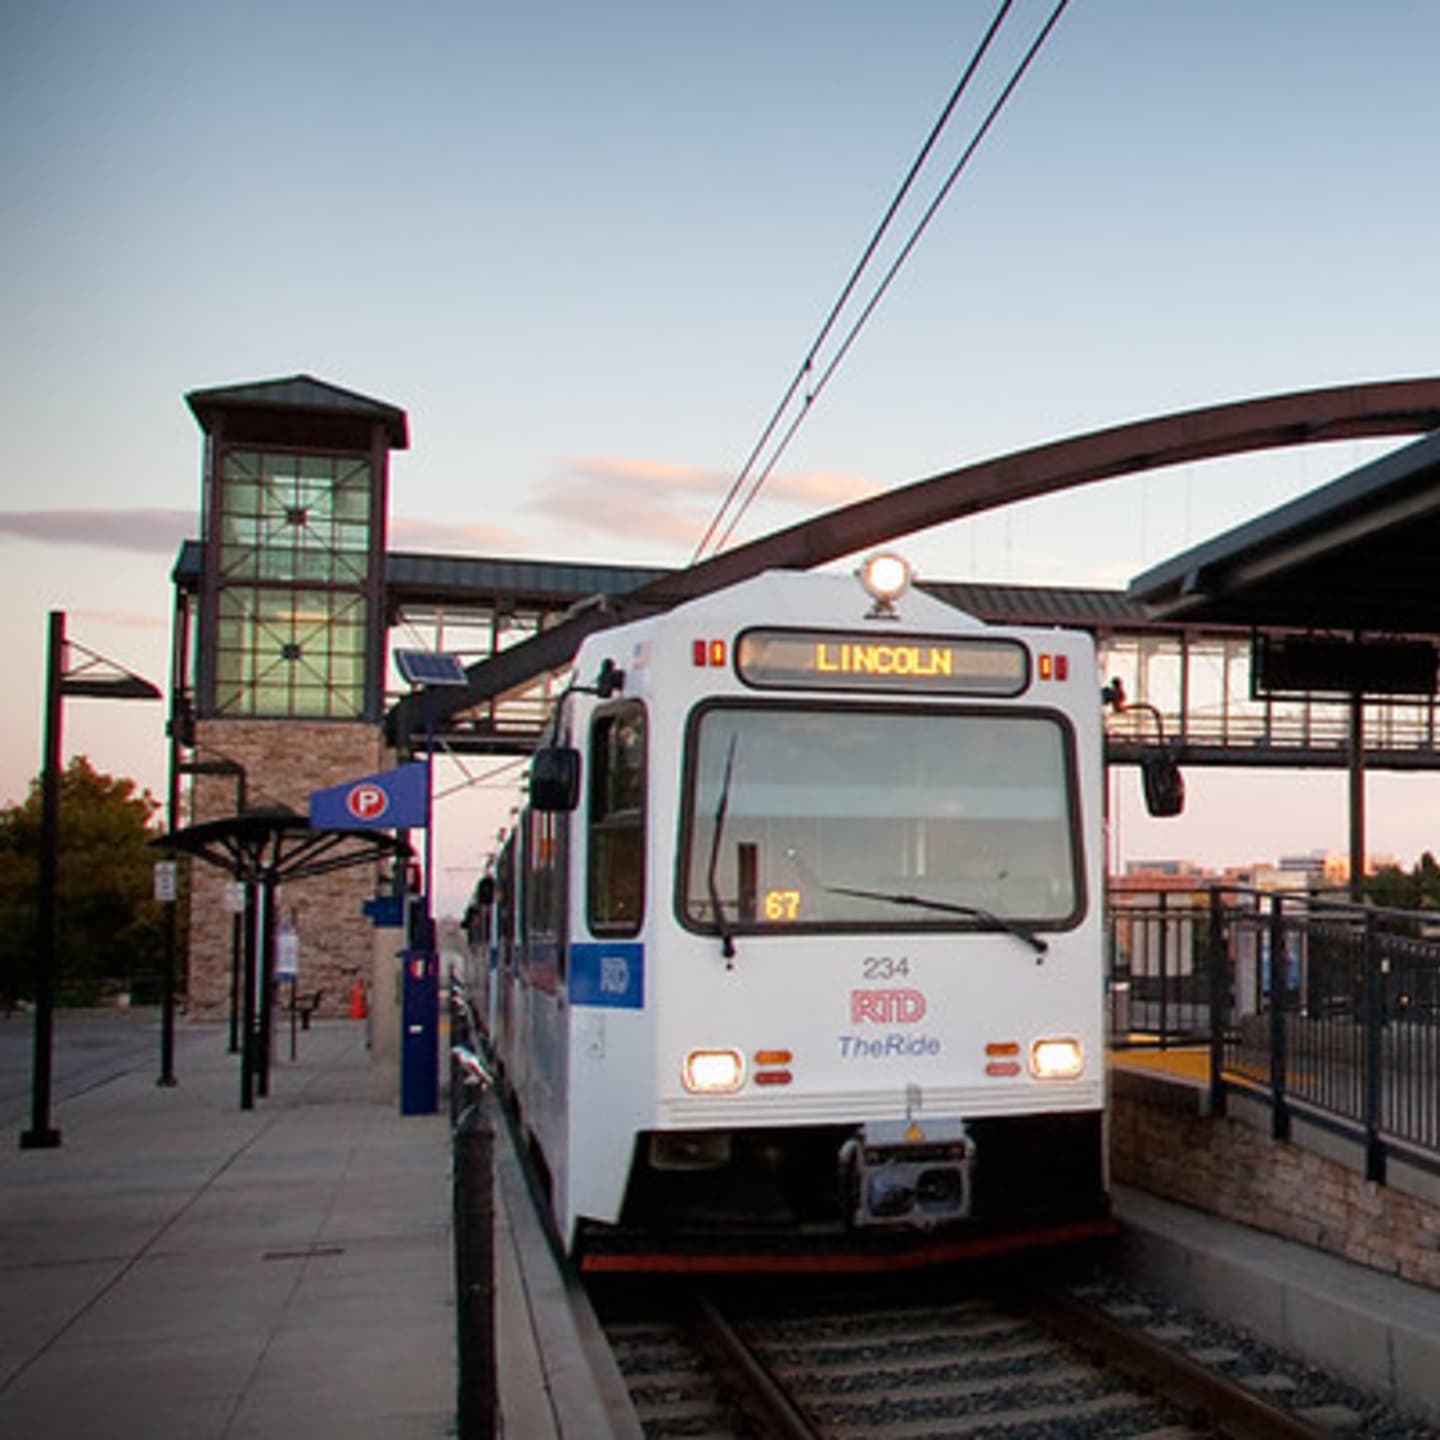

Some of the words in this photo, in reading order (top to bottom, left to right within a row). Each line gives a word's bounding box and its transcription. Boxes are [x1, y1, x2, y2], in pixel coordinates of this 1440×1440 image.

[816, 643, 953, 676] LINCOLN
[359, 791, 379, 812] P
[765, 891, 800, 919] 67
[863, 957, 909, 979] 234
[851, 989, 927, 1023] RTD
[838, 1033, 942, 1057] TheRide
